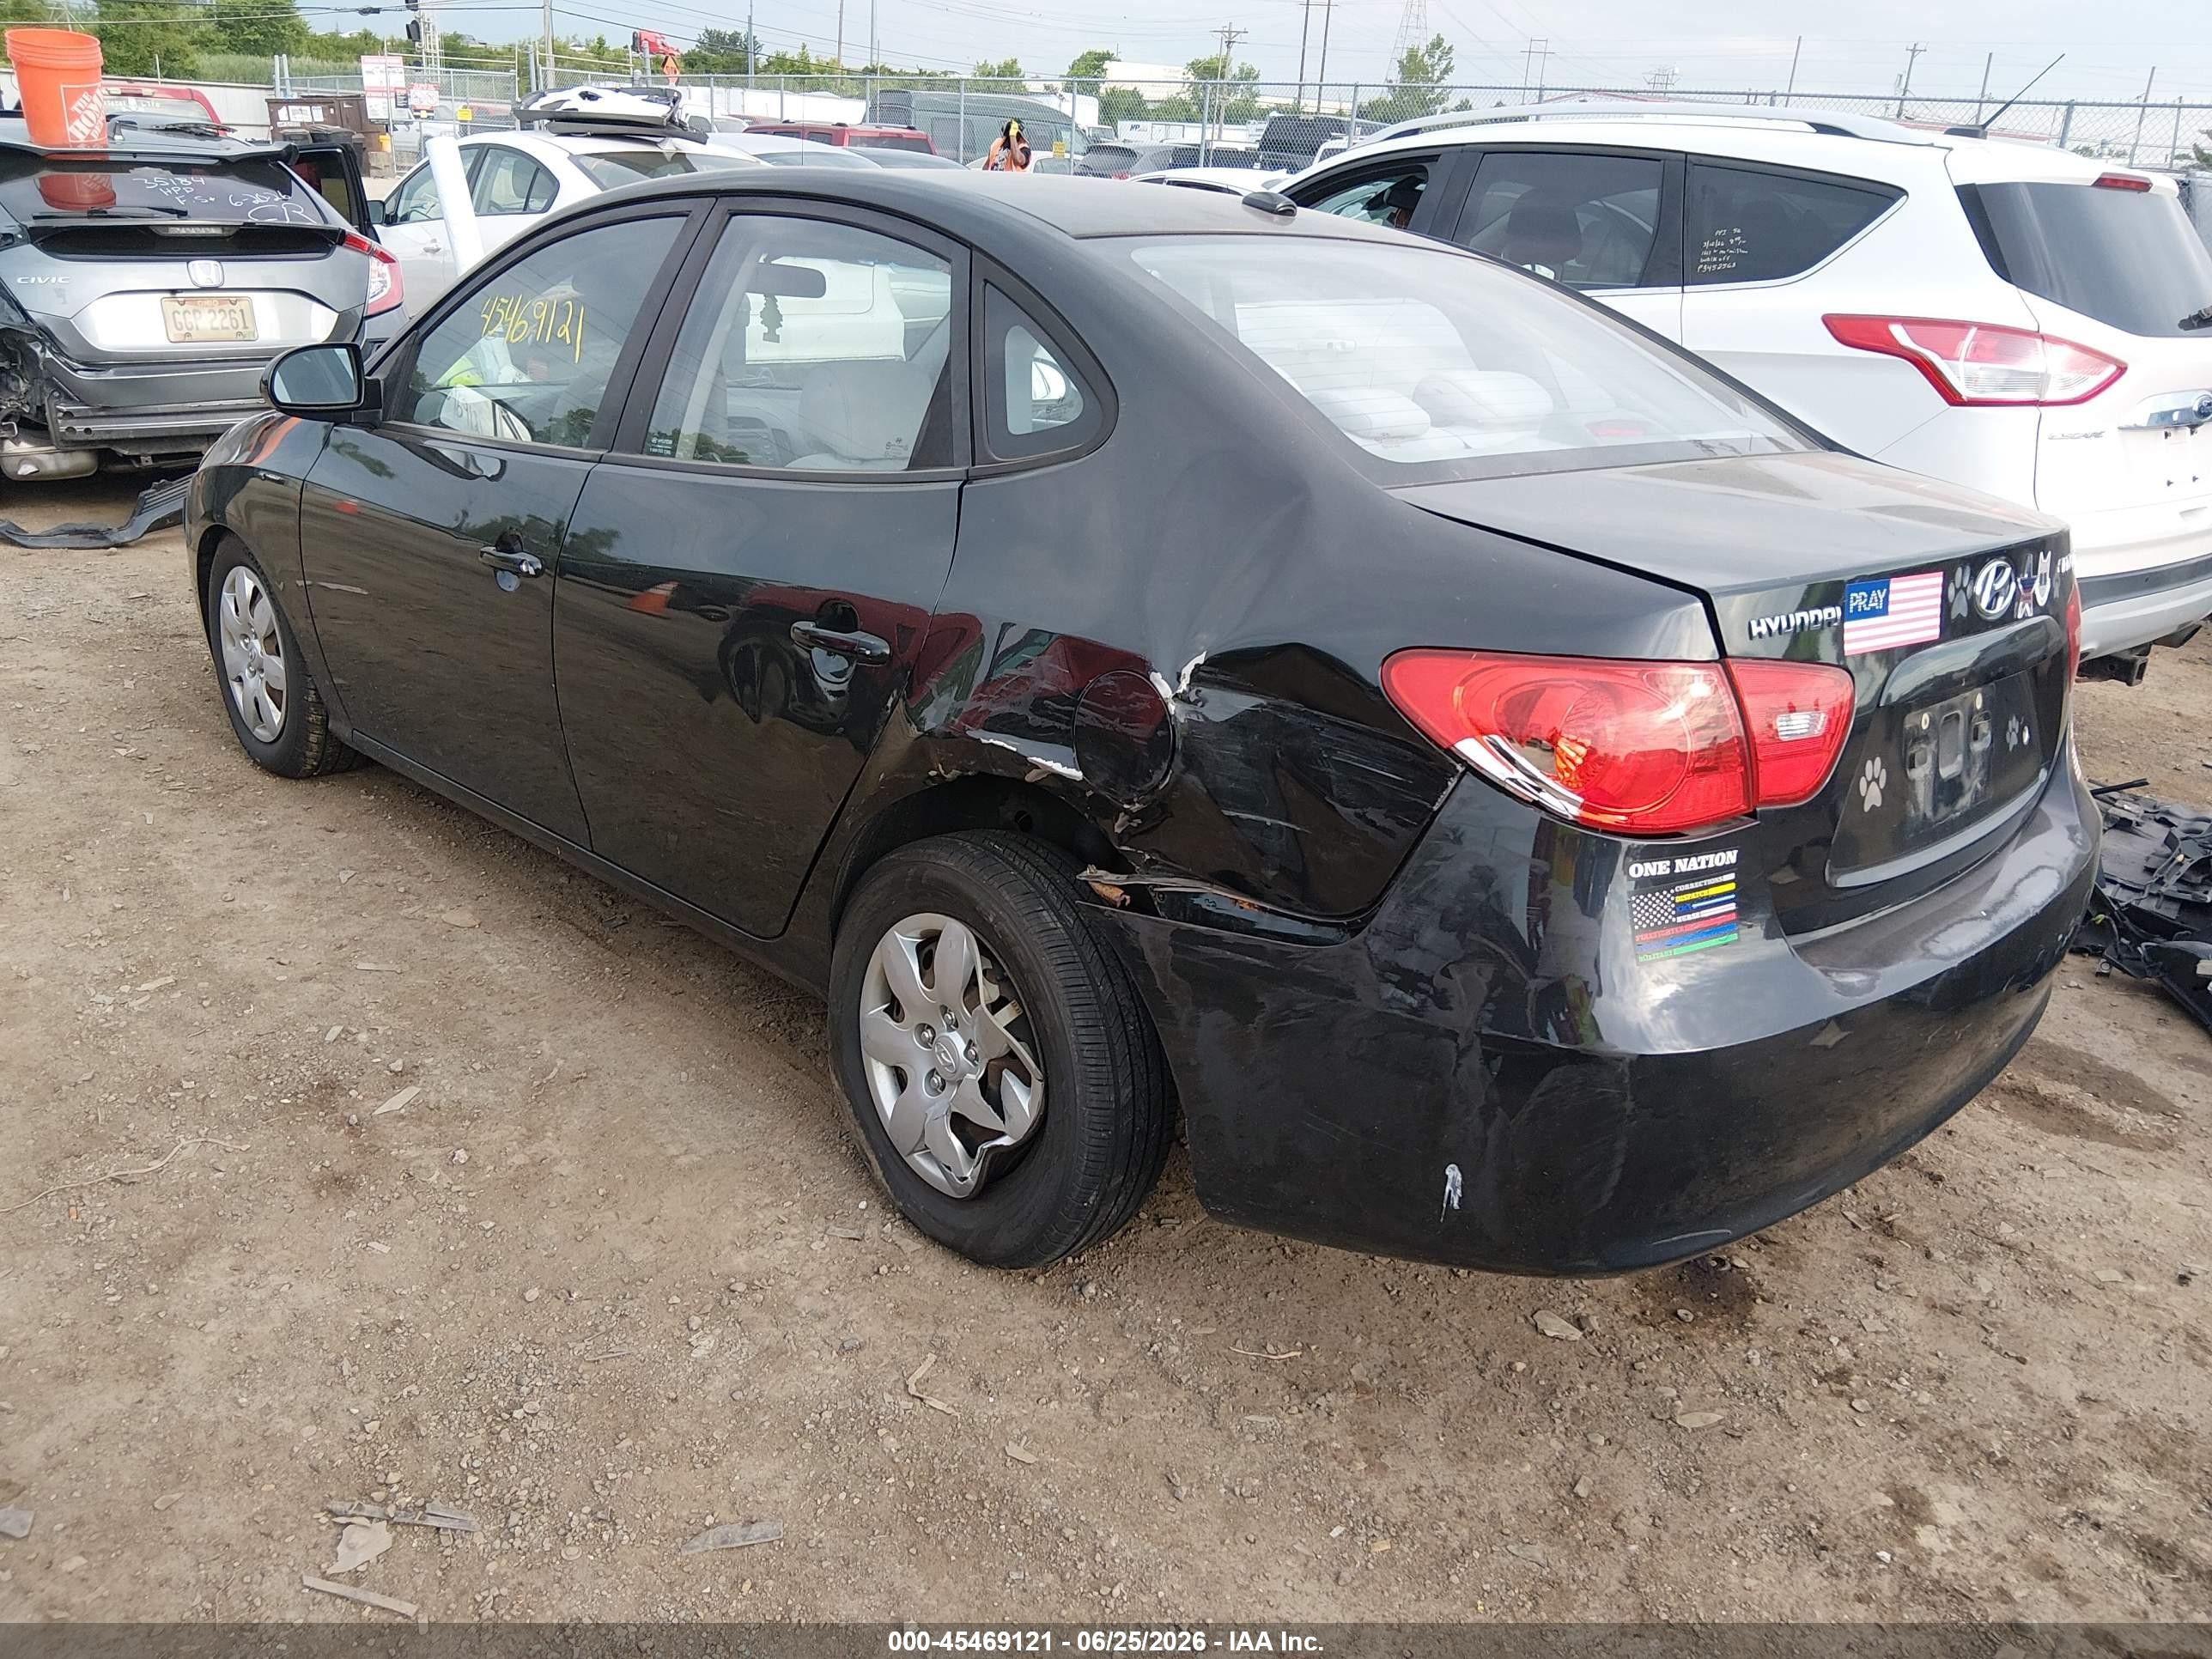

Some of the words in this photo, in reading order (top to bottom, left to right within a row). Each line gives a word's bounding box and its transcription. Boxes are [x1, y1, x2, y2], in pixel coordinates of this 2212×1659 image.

[70, 90, 93, 116] THE
[132, 177, 205, 189] 35184
[207, 308, 249, 331] 2261
[481, 294, 585, 364] 45469121
[1849, 588, 1887, 613] PRAY
[1749, 606, 1842, 639] HYUNDAI
[1629, 860, 1671, 878] ONE
[1674, 849, 1739, 873] NATION
